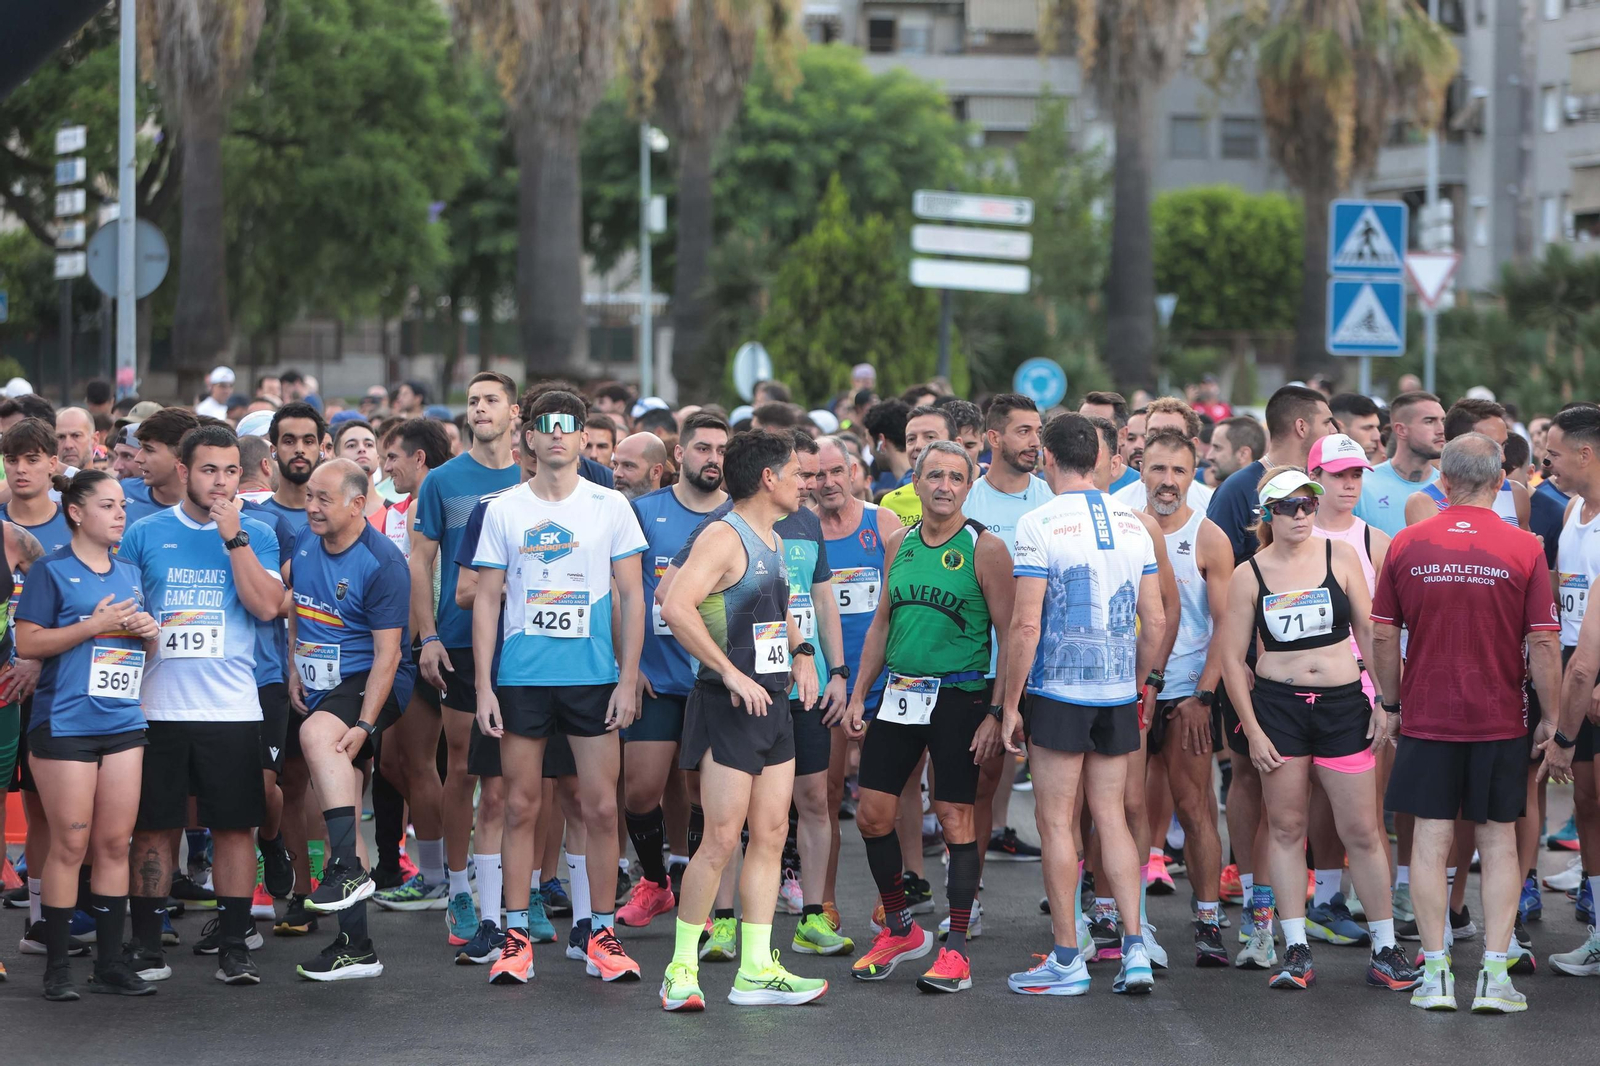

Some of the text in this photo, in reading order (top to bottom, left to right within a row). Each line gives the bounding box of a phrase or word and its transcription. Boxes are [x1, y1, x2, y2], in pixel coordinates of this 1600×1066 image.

[1053, 523, 1082, 535] enjoy!
[1091, 503, 1111, 546] JEREZ
[540, 531, 561, 545] 5K
[167, 568, 227, 584] AMERICAN'S
[1410, 564, 1510, 579] CLUB ATLETISMO
[1423, 575, 1496, 586] CIUDAD DE ARCOS
[165, 590, 223, 607] GAME OCIO
[293, 591, 342, 619] POLICIA
[839, 589, 851, 607] 5
[909, 584, 969, 615] VERDE
[1296, 593, 1325, 601] POPULAR
[532, 610, 571, 631] 426
[792, 614, 803, 629] 7
[1278, 613, 1305, 635] 71
[166, 631, 205, 650] 419
[767, 645, 785, 665] 48
[97, 670, 130, 691] 369
[302, 662, 316, 683] 10
[897, 697, 908, 717] 9
